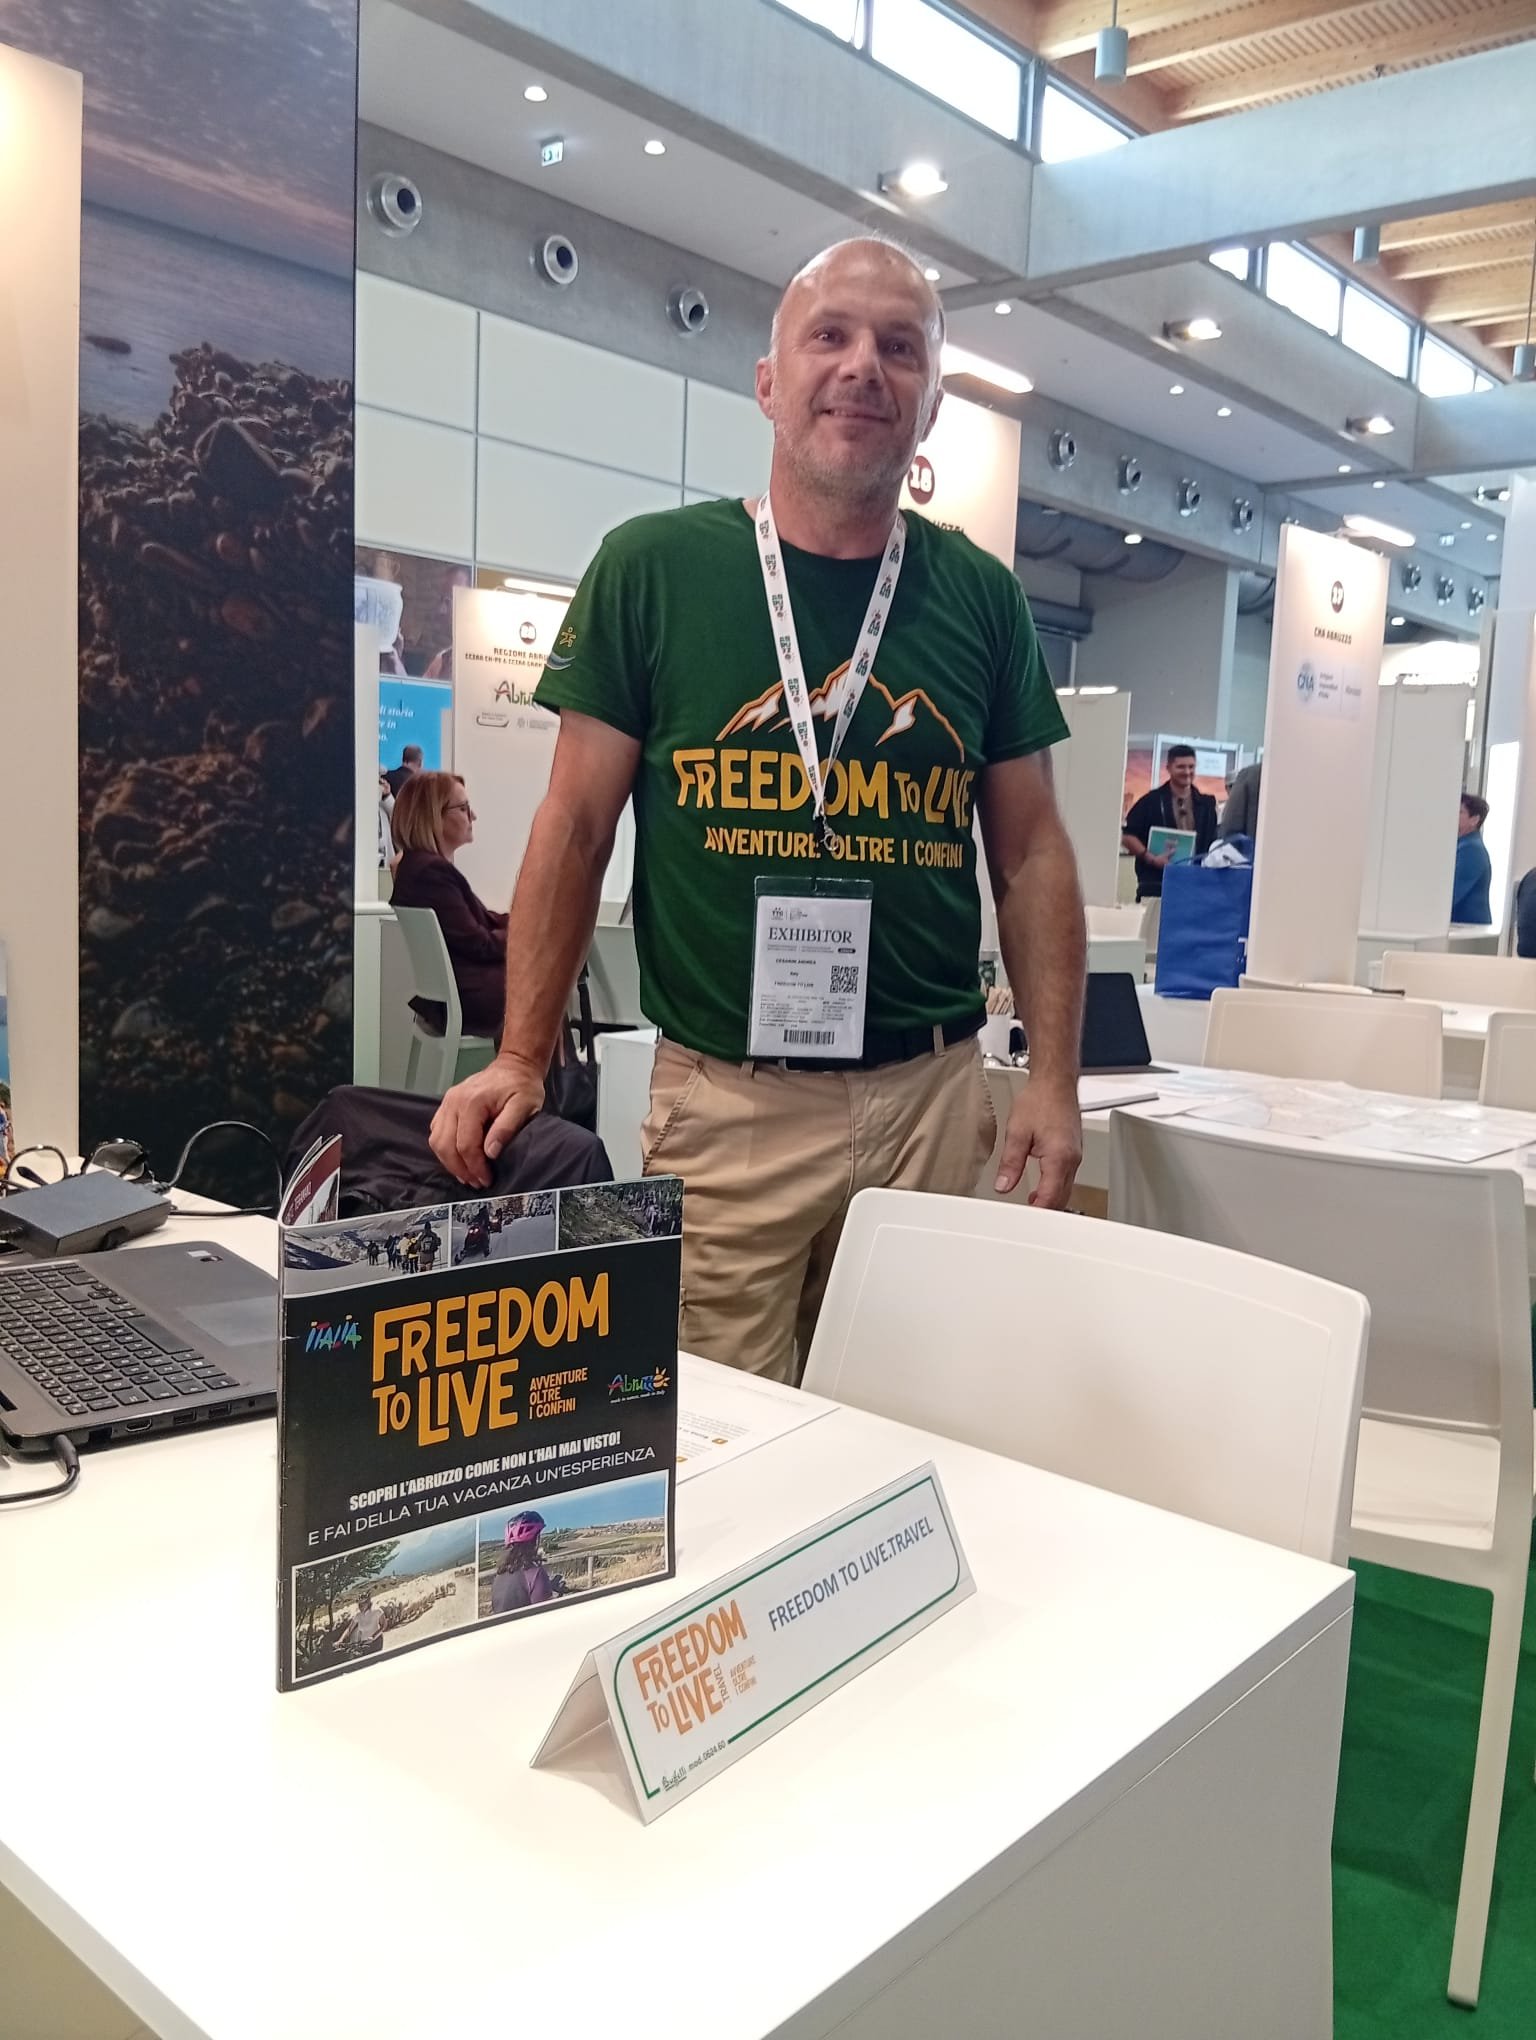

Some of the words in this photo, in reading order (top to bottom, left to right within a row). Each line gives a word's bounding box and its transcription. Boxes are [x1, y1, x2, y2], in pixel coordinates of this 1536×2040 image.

[672, 748, 889, 820] FREEDOM
[923, 766, 975, 828] LIVE
[704, 826, 821, 859] AVVENTURE
[830, 835, 896, 864] OLTRE
[902, 839, 908, 865] I
[914, 840, 963, 869] CONFINI
[768, 927, 853, 944] EXHIBITOR
[372, 1272, 610, 1383] FREEDOM
[418, 1358, 519, 1447] LIVE
[529, 1367, 588, 1391] AVVENTURE
[529, 1387, 562, 1406] OLTRE
[529, 1406, 533, 1420] I
[536, 1397, 576, 1418] CONFINI
[308, 1530, 320, 1545] E
[324, 1521, 351, 1542] FAI
[355, 1505, 411, 1532] DELLA
[414, 1494, 449, 1515] TUA
[452, 1474, 532, 1504] VACANZA
[535, 1446, 656, 1484] UN'ESPERIENZA
[350, 1485, 398, 1511] SCOPRI
[399, 1467, 463, 1497] L'ABRUZZO
[465, 1458, 500, 1480] COME
[502, 1451, 526, 1471] NON
[528, 1445, 557, 1465] L'HAI
[559, 1439, 581, 1457] MAI
[583, 1431, 621, 1452] VISTO!
[768, 1573, 840, 1632] FREEDOM
[838, 1561, 859, 1587] TO
[859, 1516, 934, 1574] LIVE.TRAVEL
[632, 1599, 748, 1701] FREEDOM
[667, 1667, 723, 1735] LIVE
